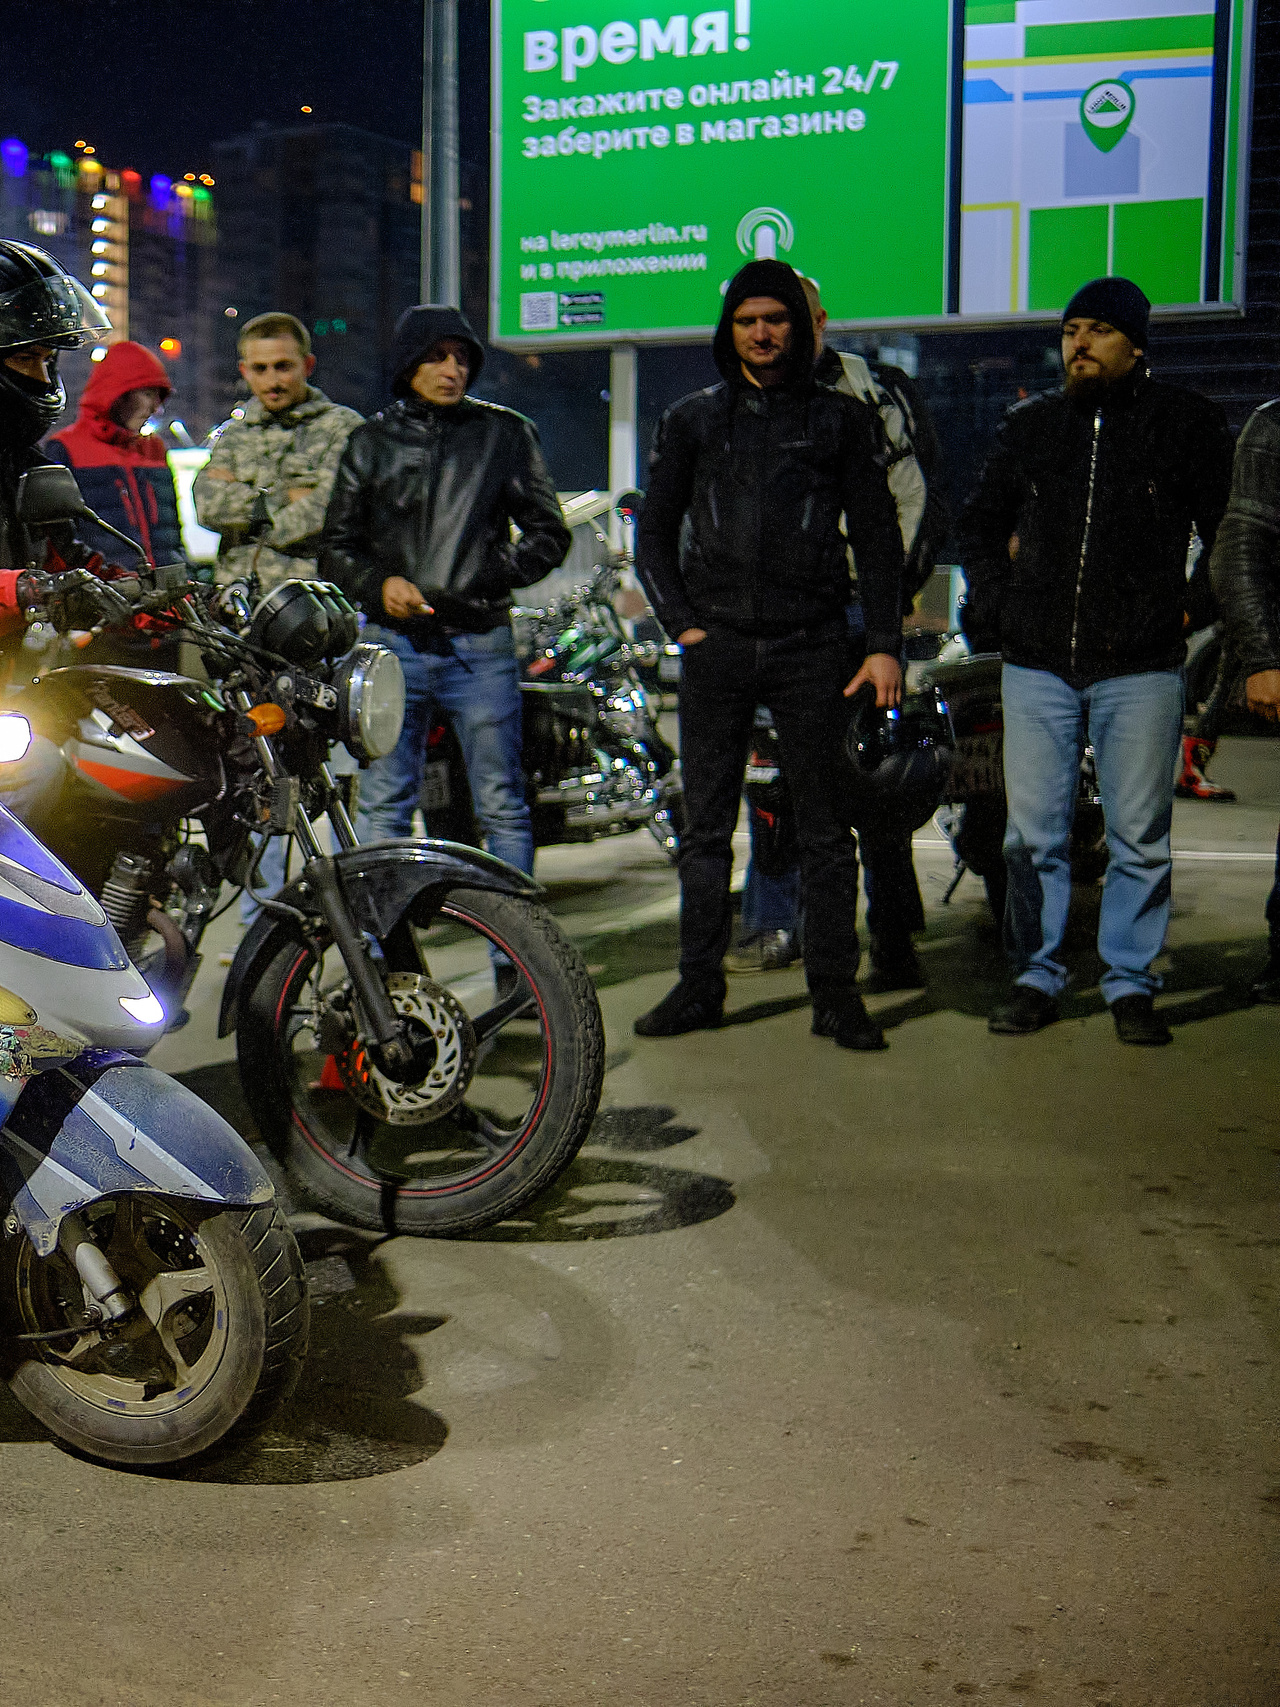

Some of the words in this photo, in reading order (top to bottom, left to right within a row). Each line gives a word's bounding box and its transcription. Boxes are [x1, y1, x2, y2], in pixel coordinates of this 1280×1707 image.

[523, 0, 751, 82] время!
[522, 86, 684, 123] Закажите
[688, 69, 816, 108] онлайн
[821, 60, 900, 95] 24/7
[522, 124, 671, 159] заберите
[675, 122, 695, 146] в
[701, 108, 866, 143] магазине
[521, 235, 548, 252] на
[551, 222, 708, 253] leroymerlin.ru
[556, 253, 707, 282] приложении
